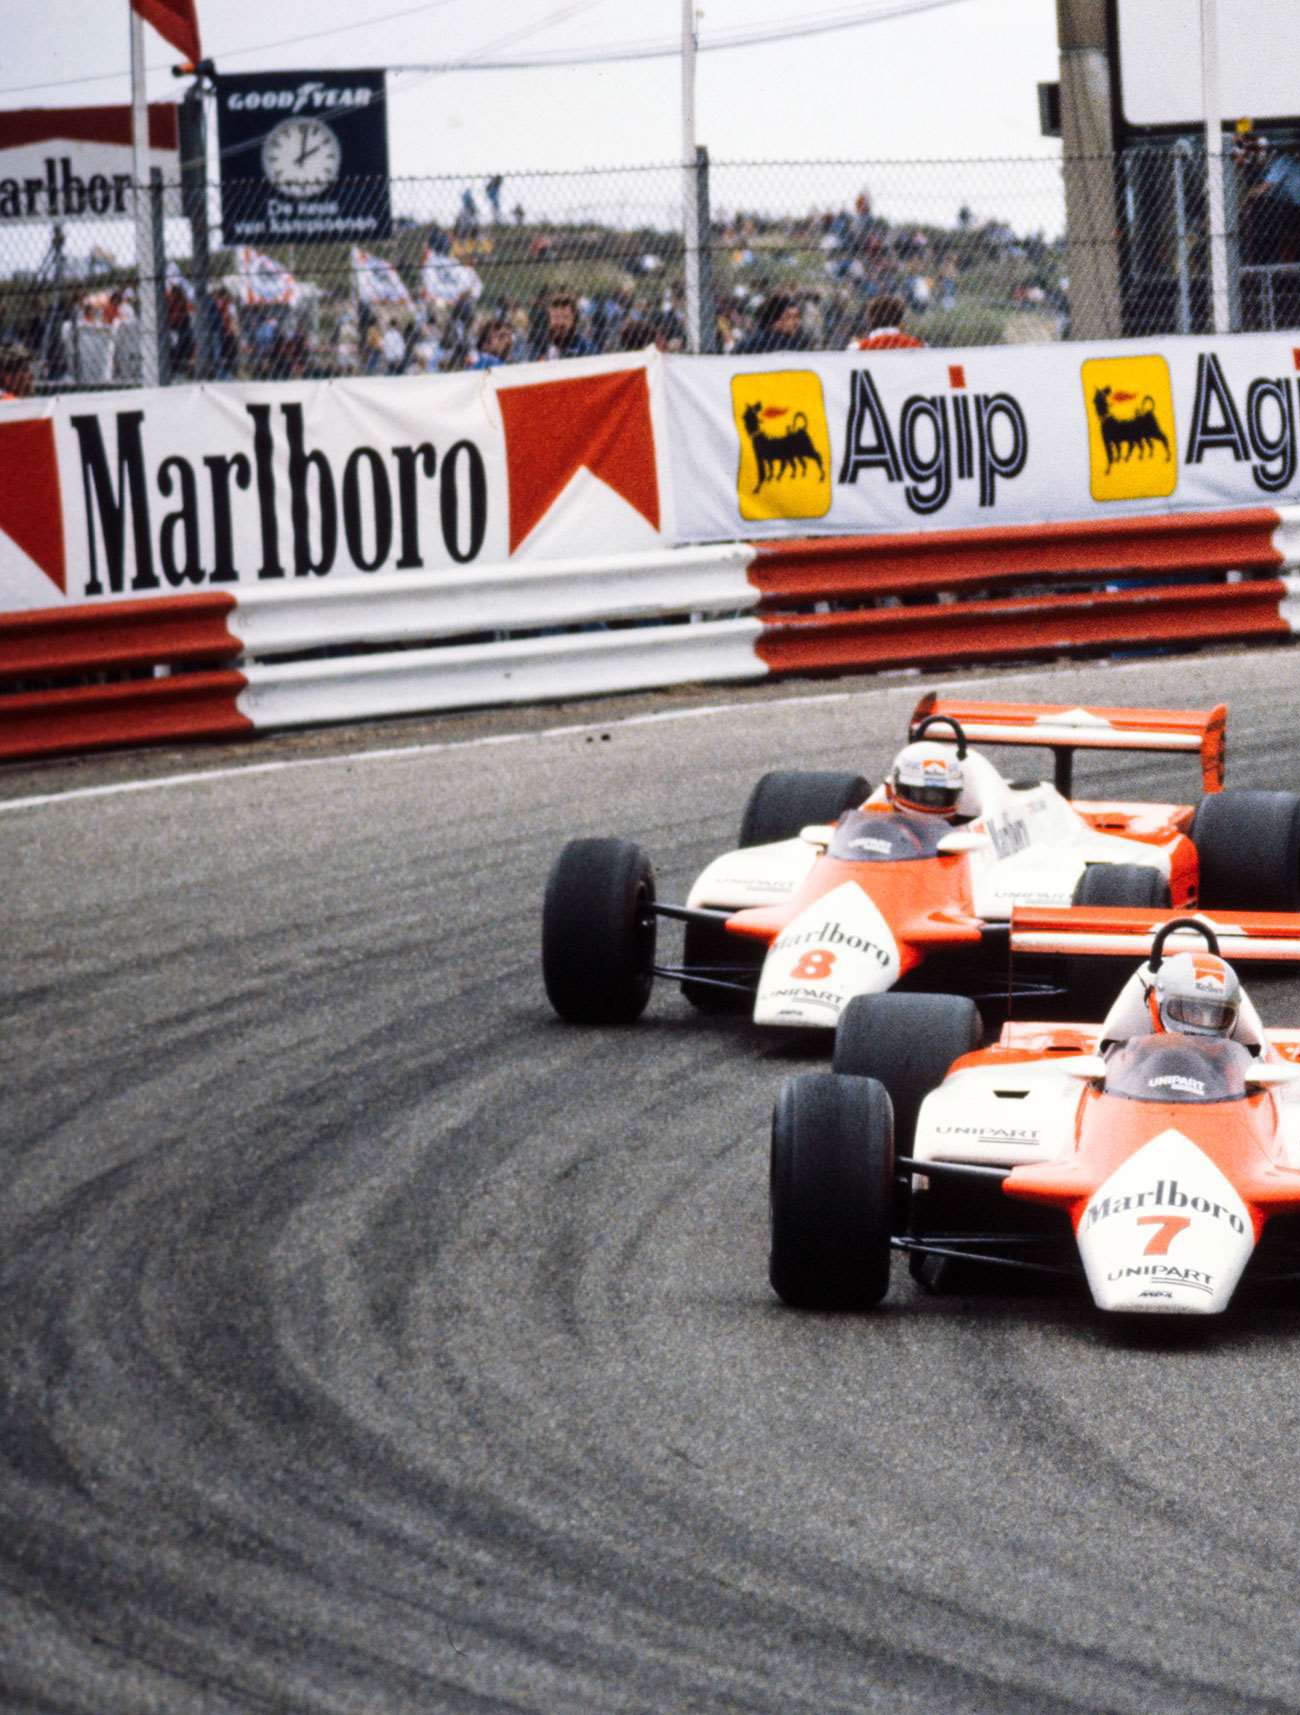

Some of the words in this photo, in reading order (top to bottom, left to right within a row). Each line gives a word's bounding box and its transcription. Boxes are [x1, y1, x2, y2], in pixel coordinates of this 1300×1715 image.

[227, 82, 372, 113] GOODYEAR
[0, 156, 131, 217] arlbor
[839, 364, 1028, 515] Agip
[70, 402, 488, 596] Marlboro
[789, 949, 837, 981] 8
[1147, 1074, 1206, 1091] UNIPART
[936, 1126, 1040, 1138] UNIPART
[1085, 1180, 1245, 1235] Marlboro
[1137, 1215, 1191, 1256] 7
[1106, 1264, 1214, 1285] UNIPART
